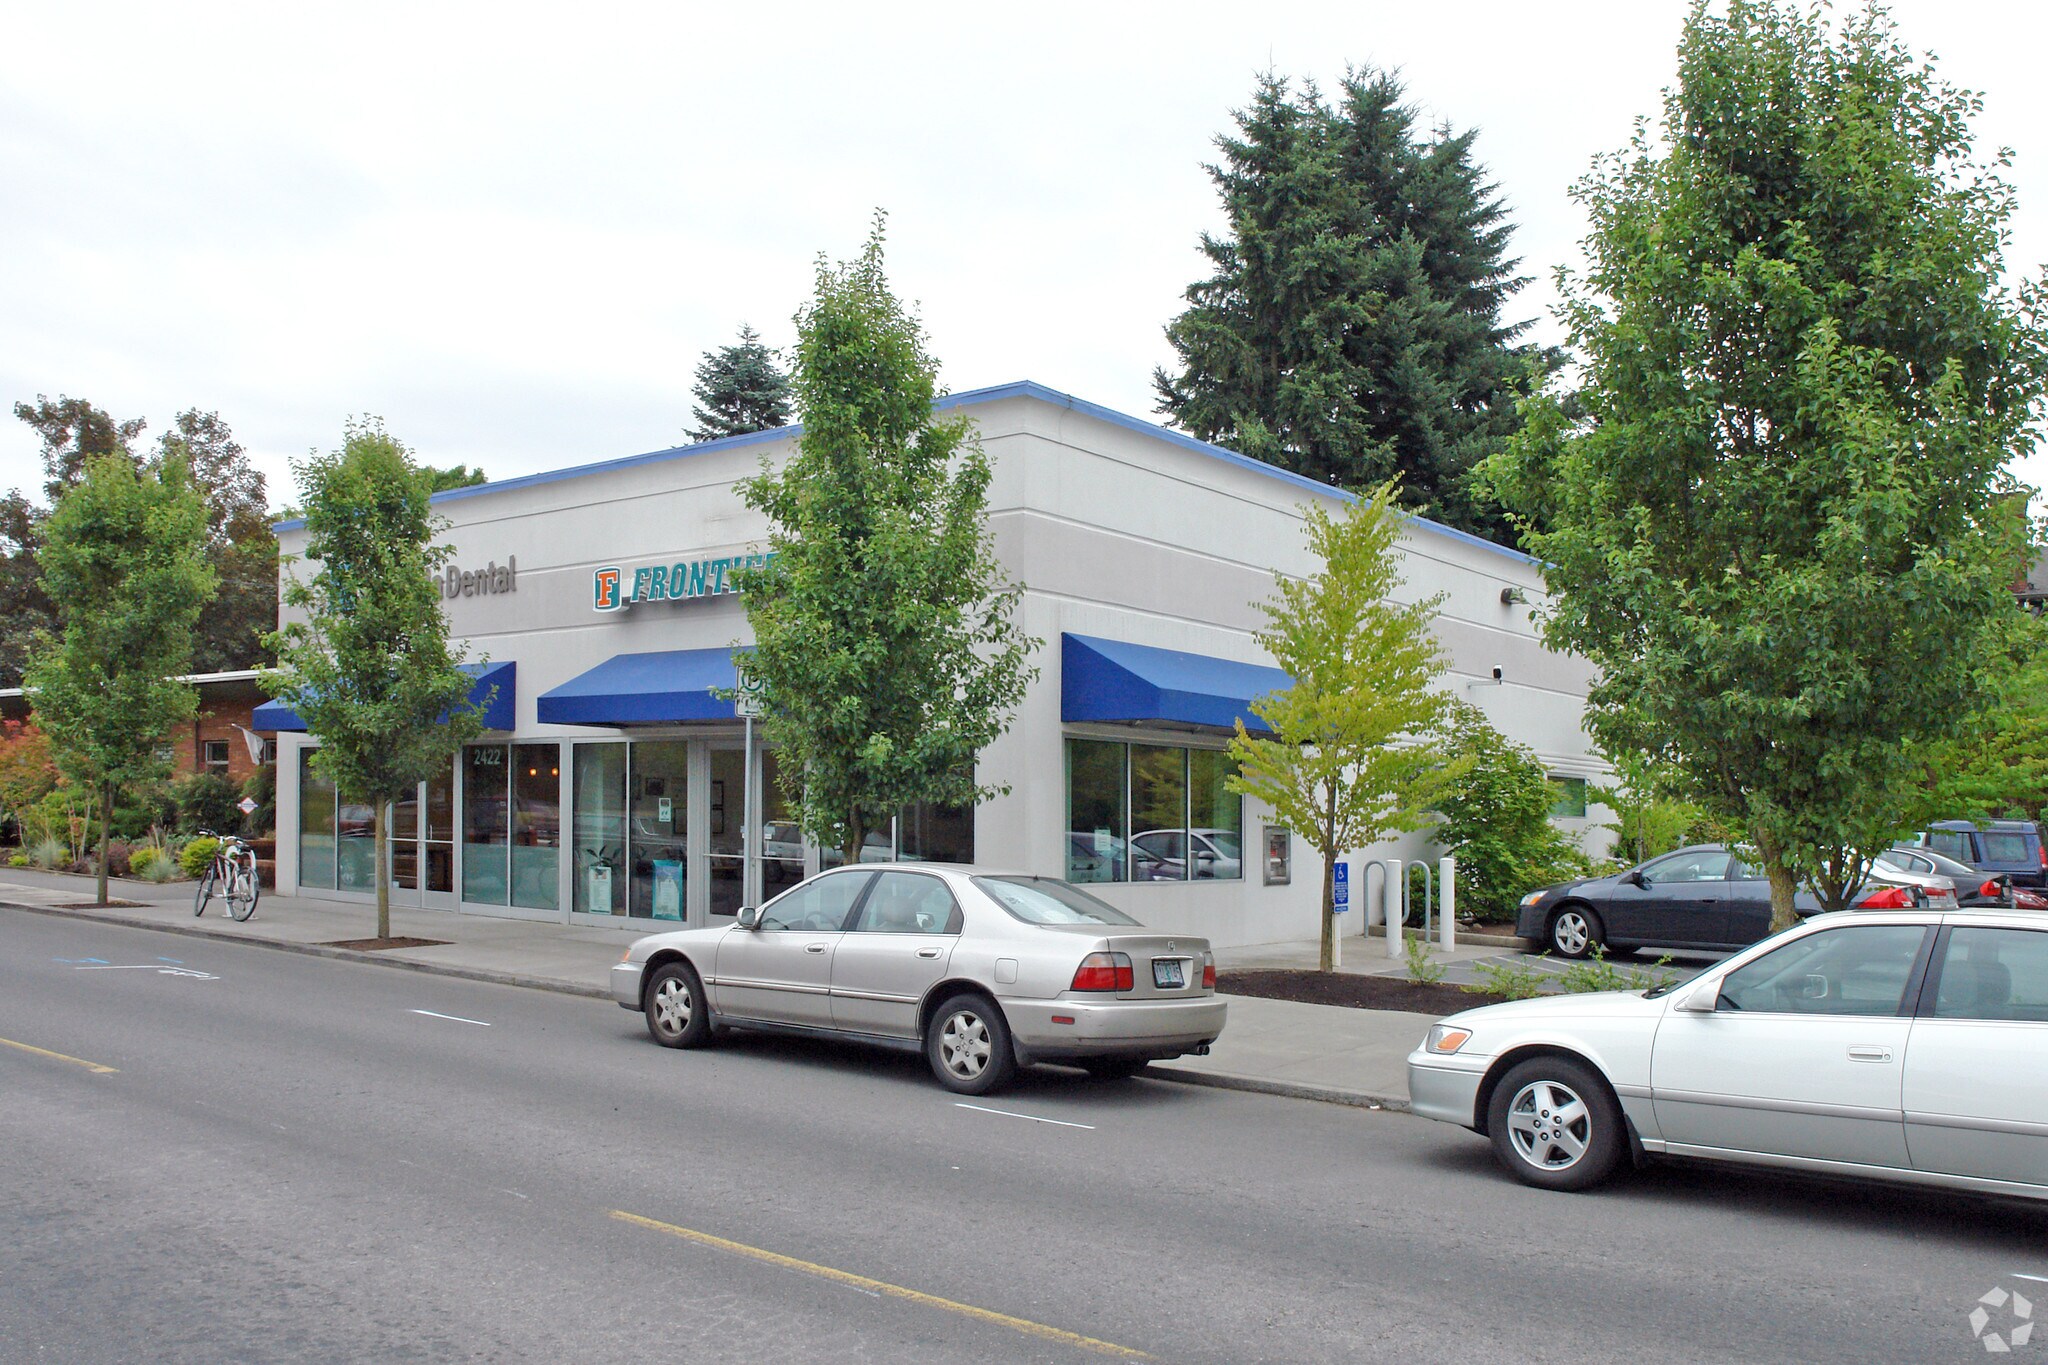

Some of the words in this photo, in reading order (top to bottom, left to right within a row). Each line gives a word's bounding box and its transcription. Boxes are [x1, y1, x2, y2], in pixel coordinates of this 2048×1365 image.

[446, 555, 516, 598] Dental
[597, 569, 618, 607] F
[474, 749, 501, 765] 2422
